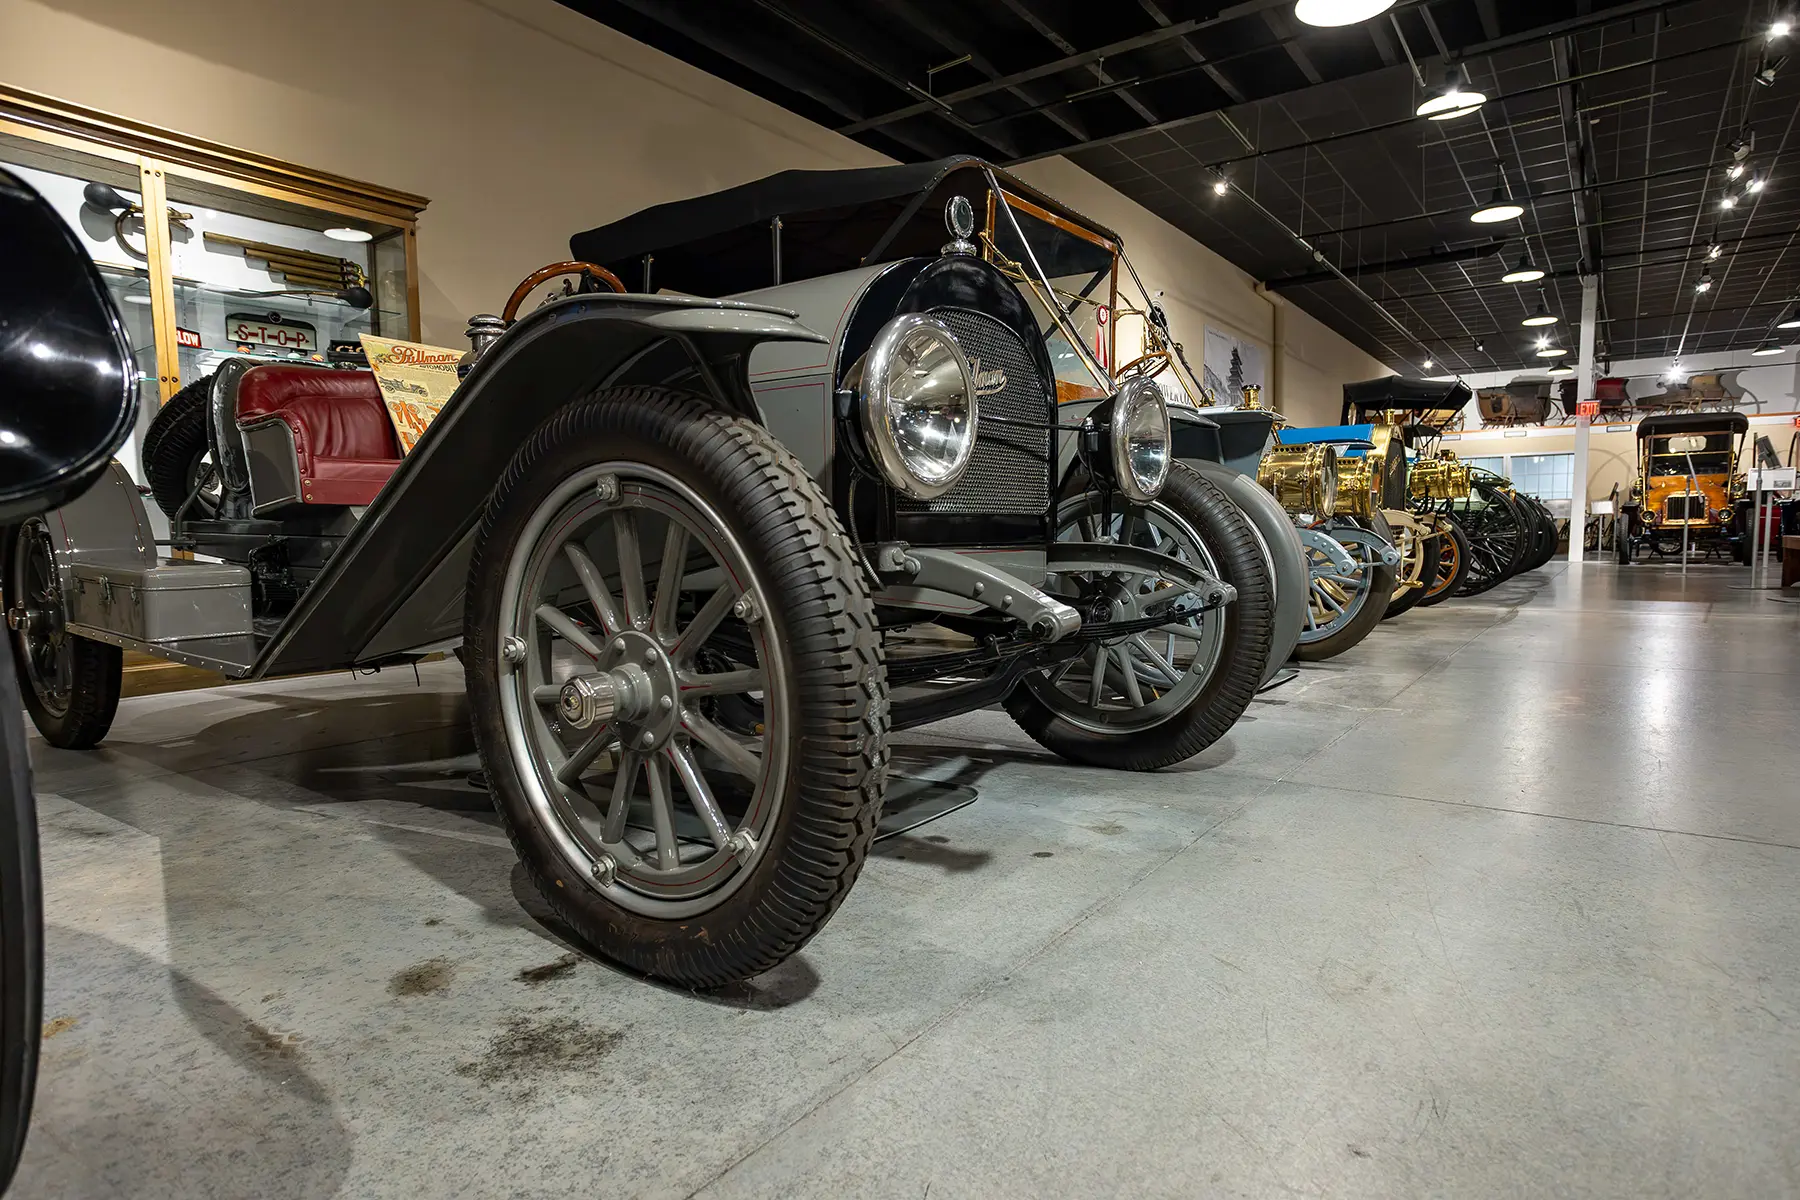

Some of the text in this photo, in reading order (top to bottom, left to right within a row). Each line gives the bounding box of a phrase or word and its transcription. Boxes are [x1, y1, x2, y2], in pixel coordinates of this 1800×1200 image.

[176, 330, 199, 347] LOW
[388, 345, 460, 366] Pullman
[1580, 402, 1597, 416] EXIT
